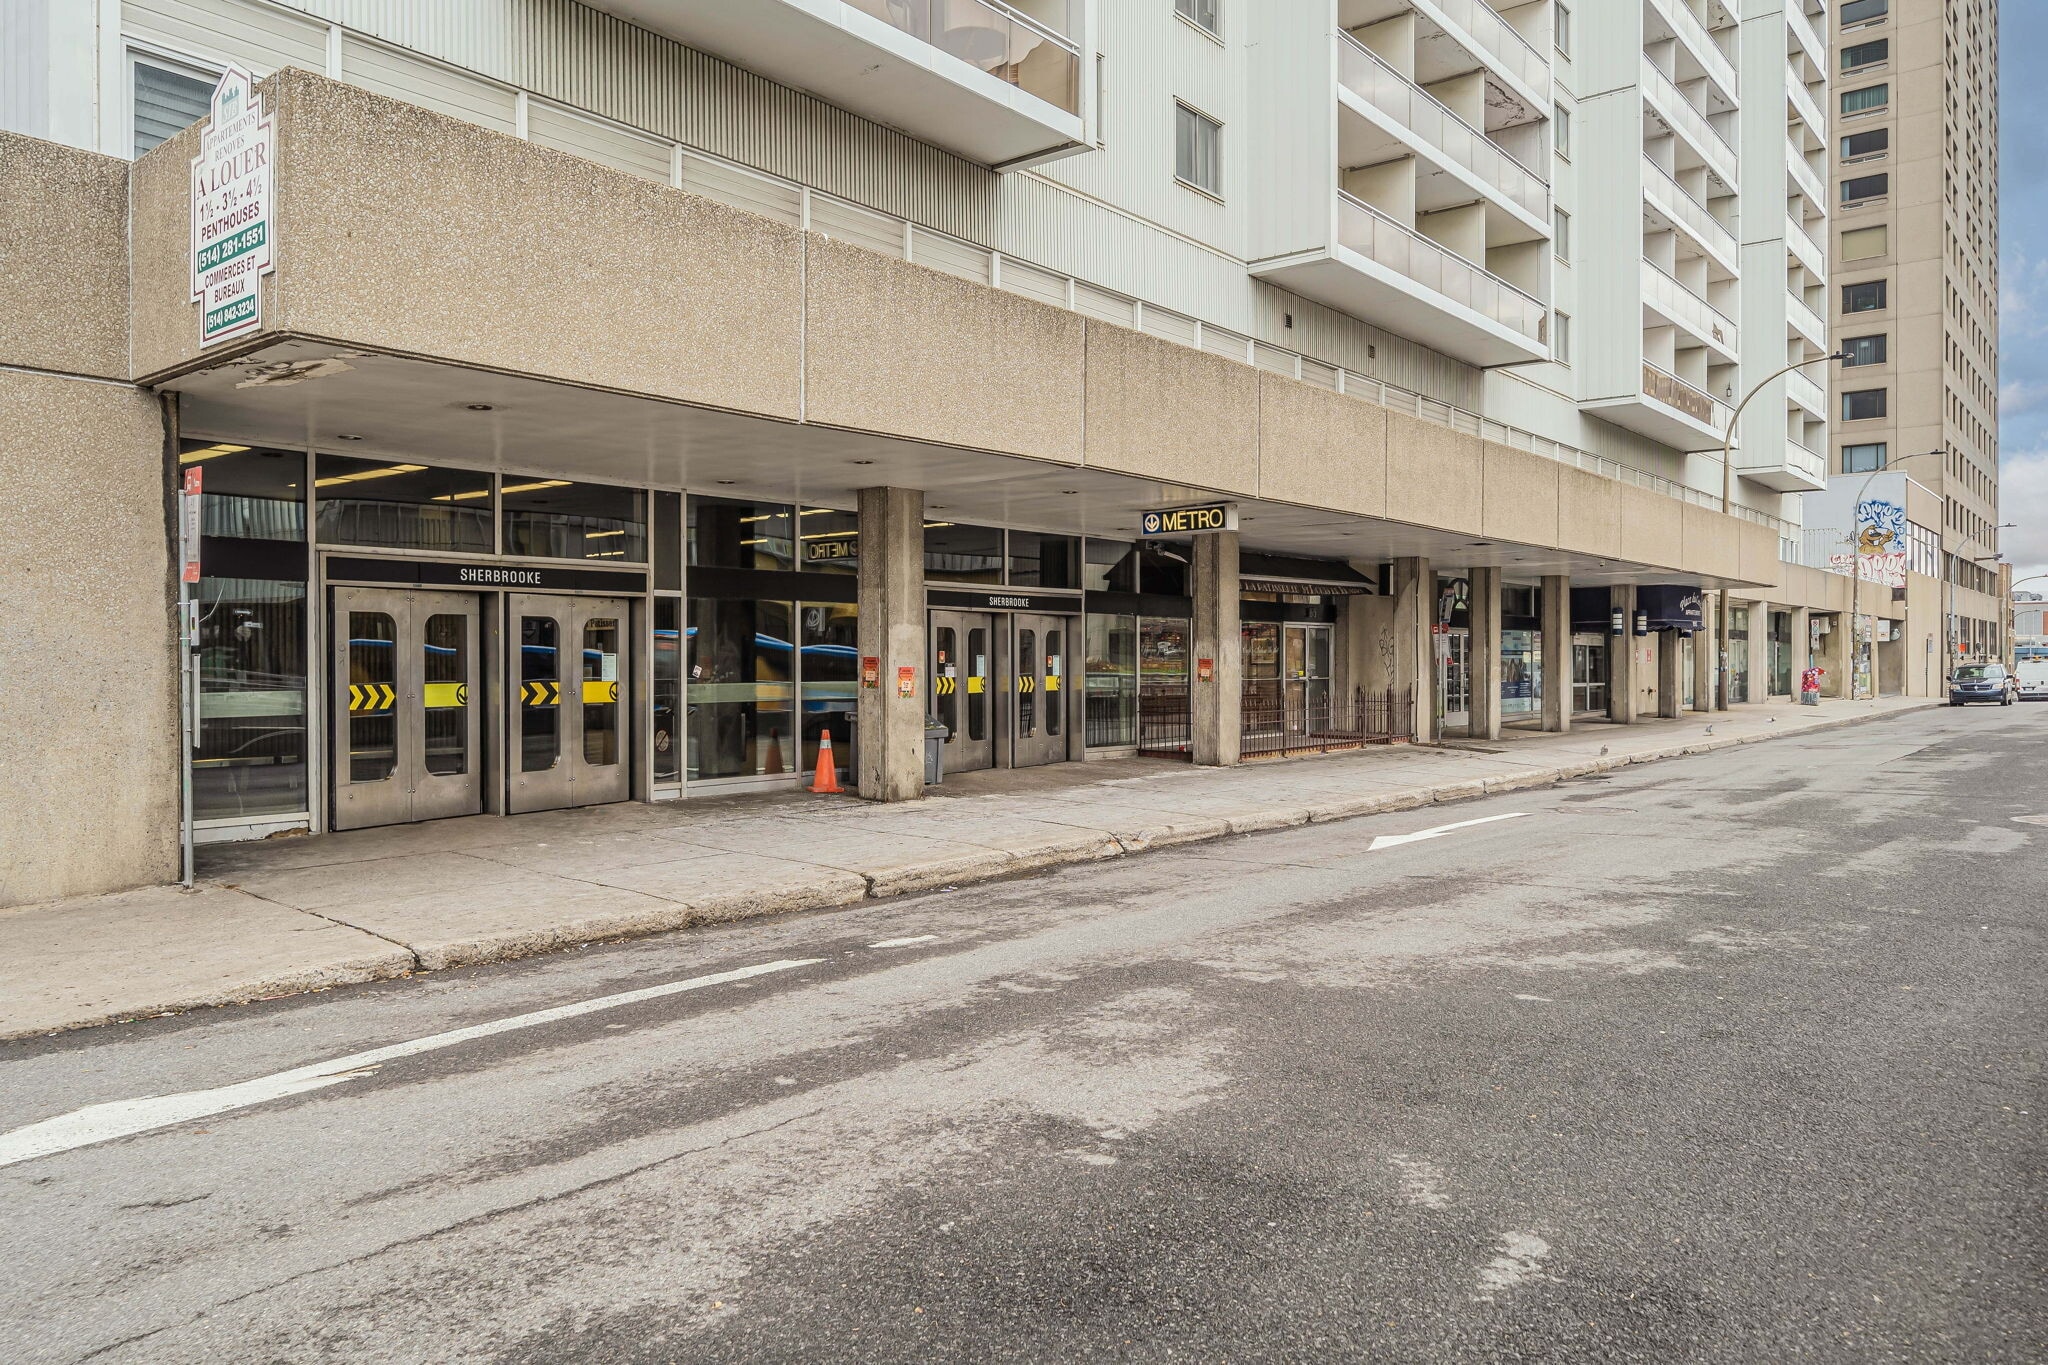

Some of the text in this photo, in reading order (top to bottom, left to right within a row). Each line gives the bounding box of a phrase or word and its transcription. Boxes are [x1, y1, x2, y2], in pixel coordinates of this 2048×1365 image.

[206, 111, 257, 152] APPARTEMENTS
[210, 142, 267, 193] LOUER
[201, 200, 260, 243] PENTHOUSES
[198, 225, 264, 271] (514) 281-1551
[204, 255, 256, 289] COMMERCES ET
[214, 278, 245, 303] BUREAUX
[207, 298, 255, 330] (514) 842-3234
[460, 568, 541, 584] SHERBROOKE
[989, 596, 1030, 607] SHERBROOKE
